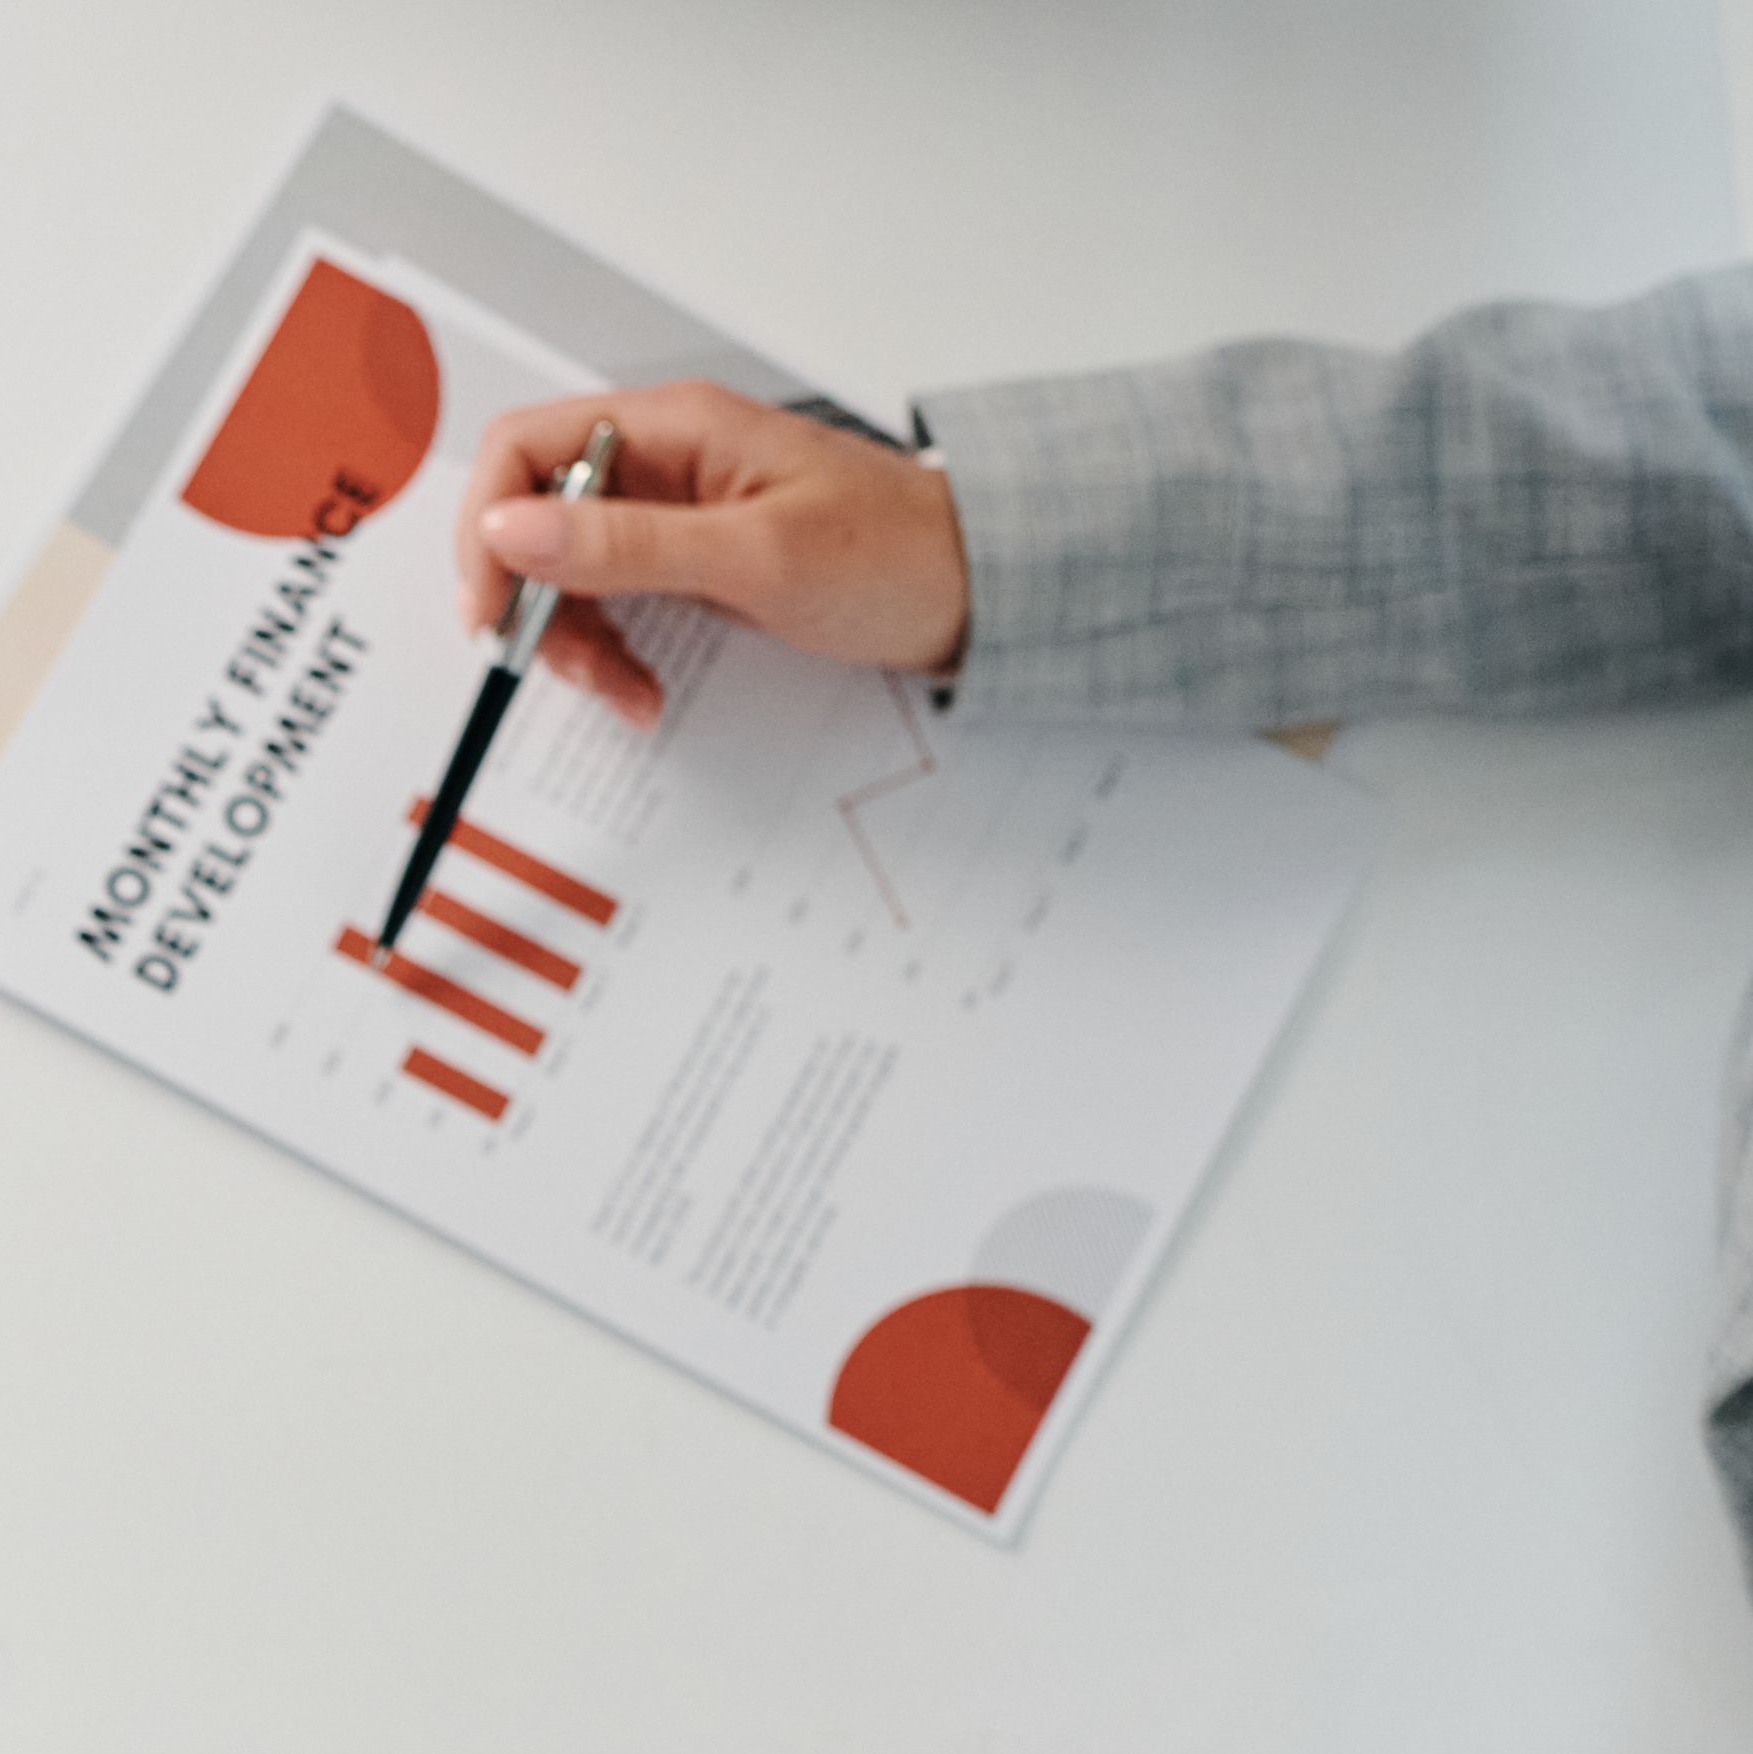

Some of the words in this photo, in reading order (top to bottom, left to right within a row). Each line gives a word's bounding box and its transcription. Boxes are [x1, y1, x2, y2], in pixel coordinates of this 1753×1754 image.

[74, 699, 245, 963] MONTHLY
[227, 467, 380, 699] FINANCE
[133, 620, 371, 998] DEVELOPMENT
